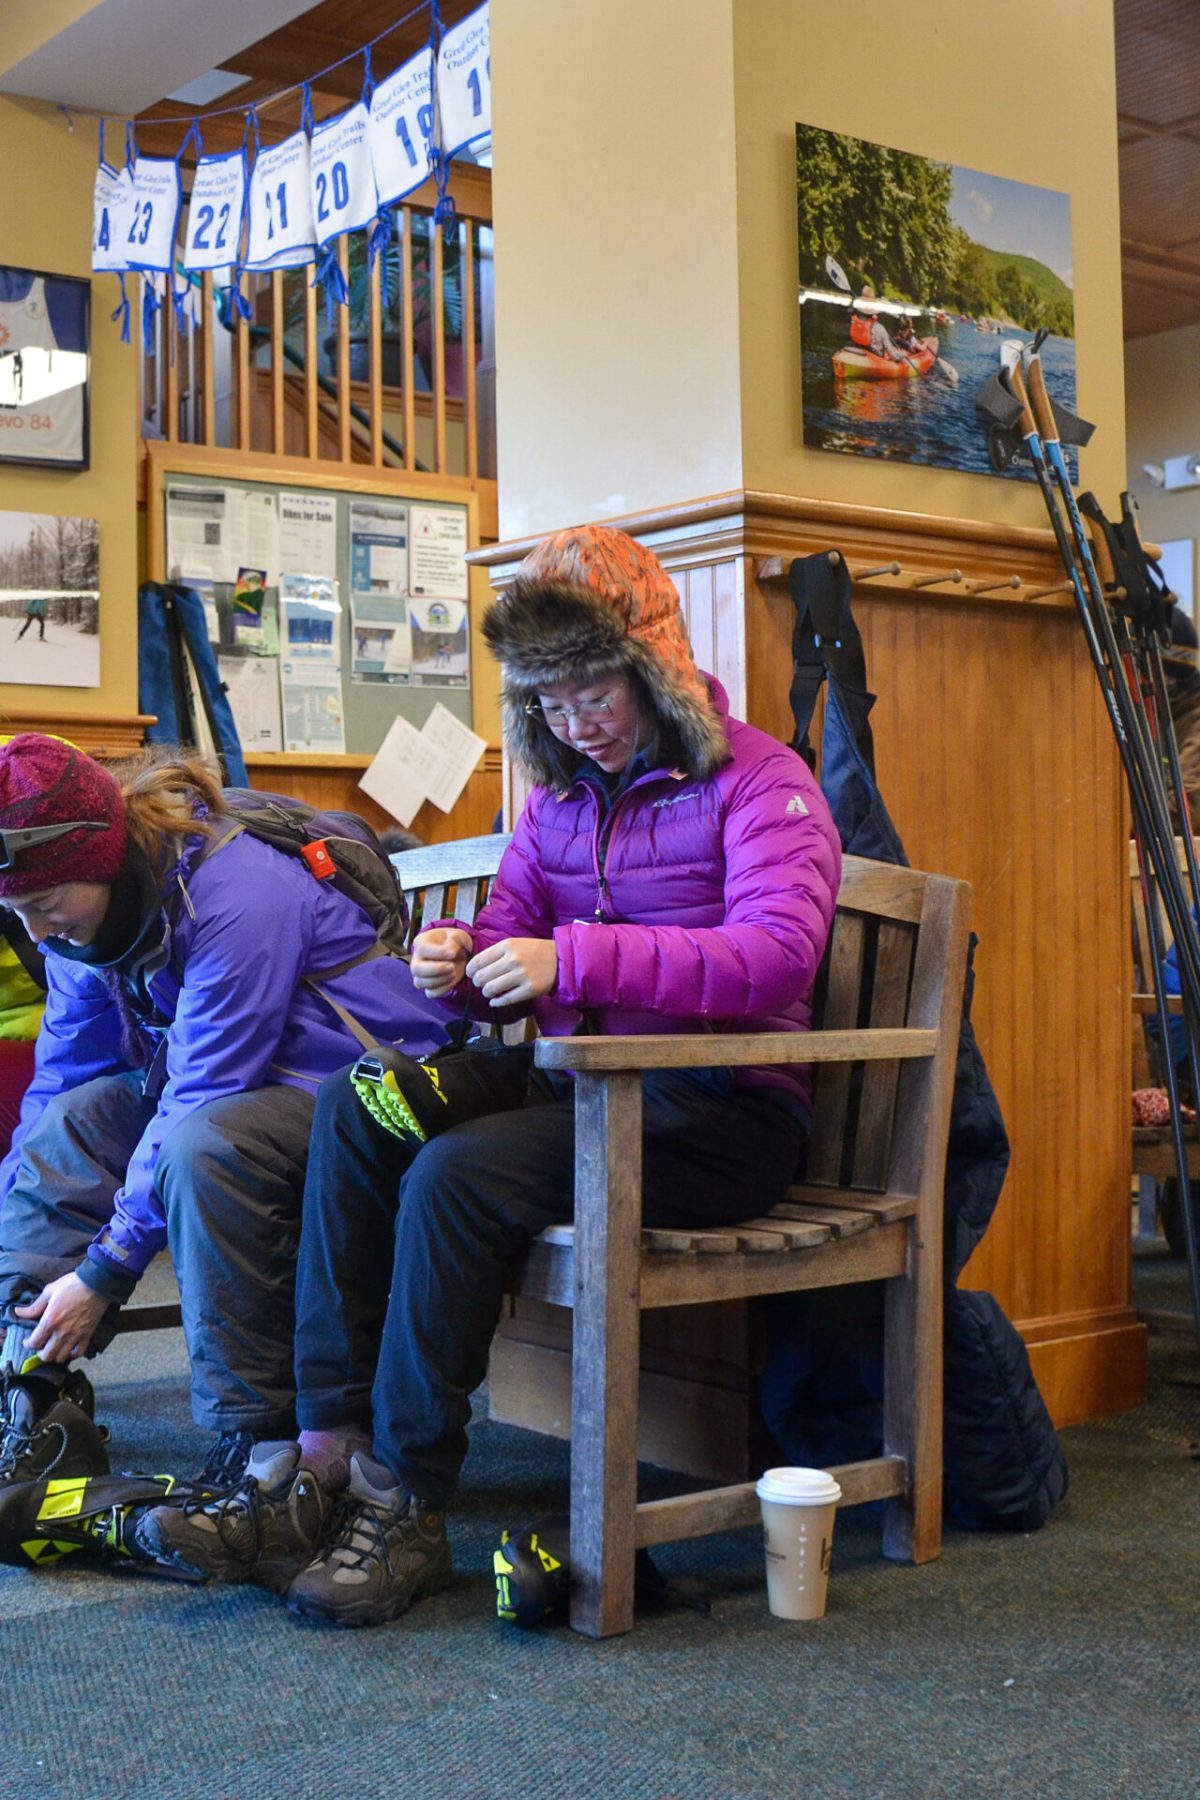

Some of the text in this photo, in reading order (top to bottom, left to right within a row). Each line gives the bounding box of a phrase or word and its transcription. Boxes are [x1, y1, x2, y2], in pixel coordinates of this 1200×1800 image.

[315, 161, 349, 223] 20
[128, 199, 153, 246] 23
[192, 202, 231, 250] 22
[30, 414, 52, 431] 84
[283, 508, 332, 523] Bikes for Sale
